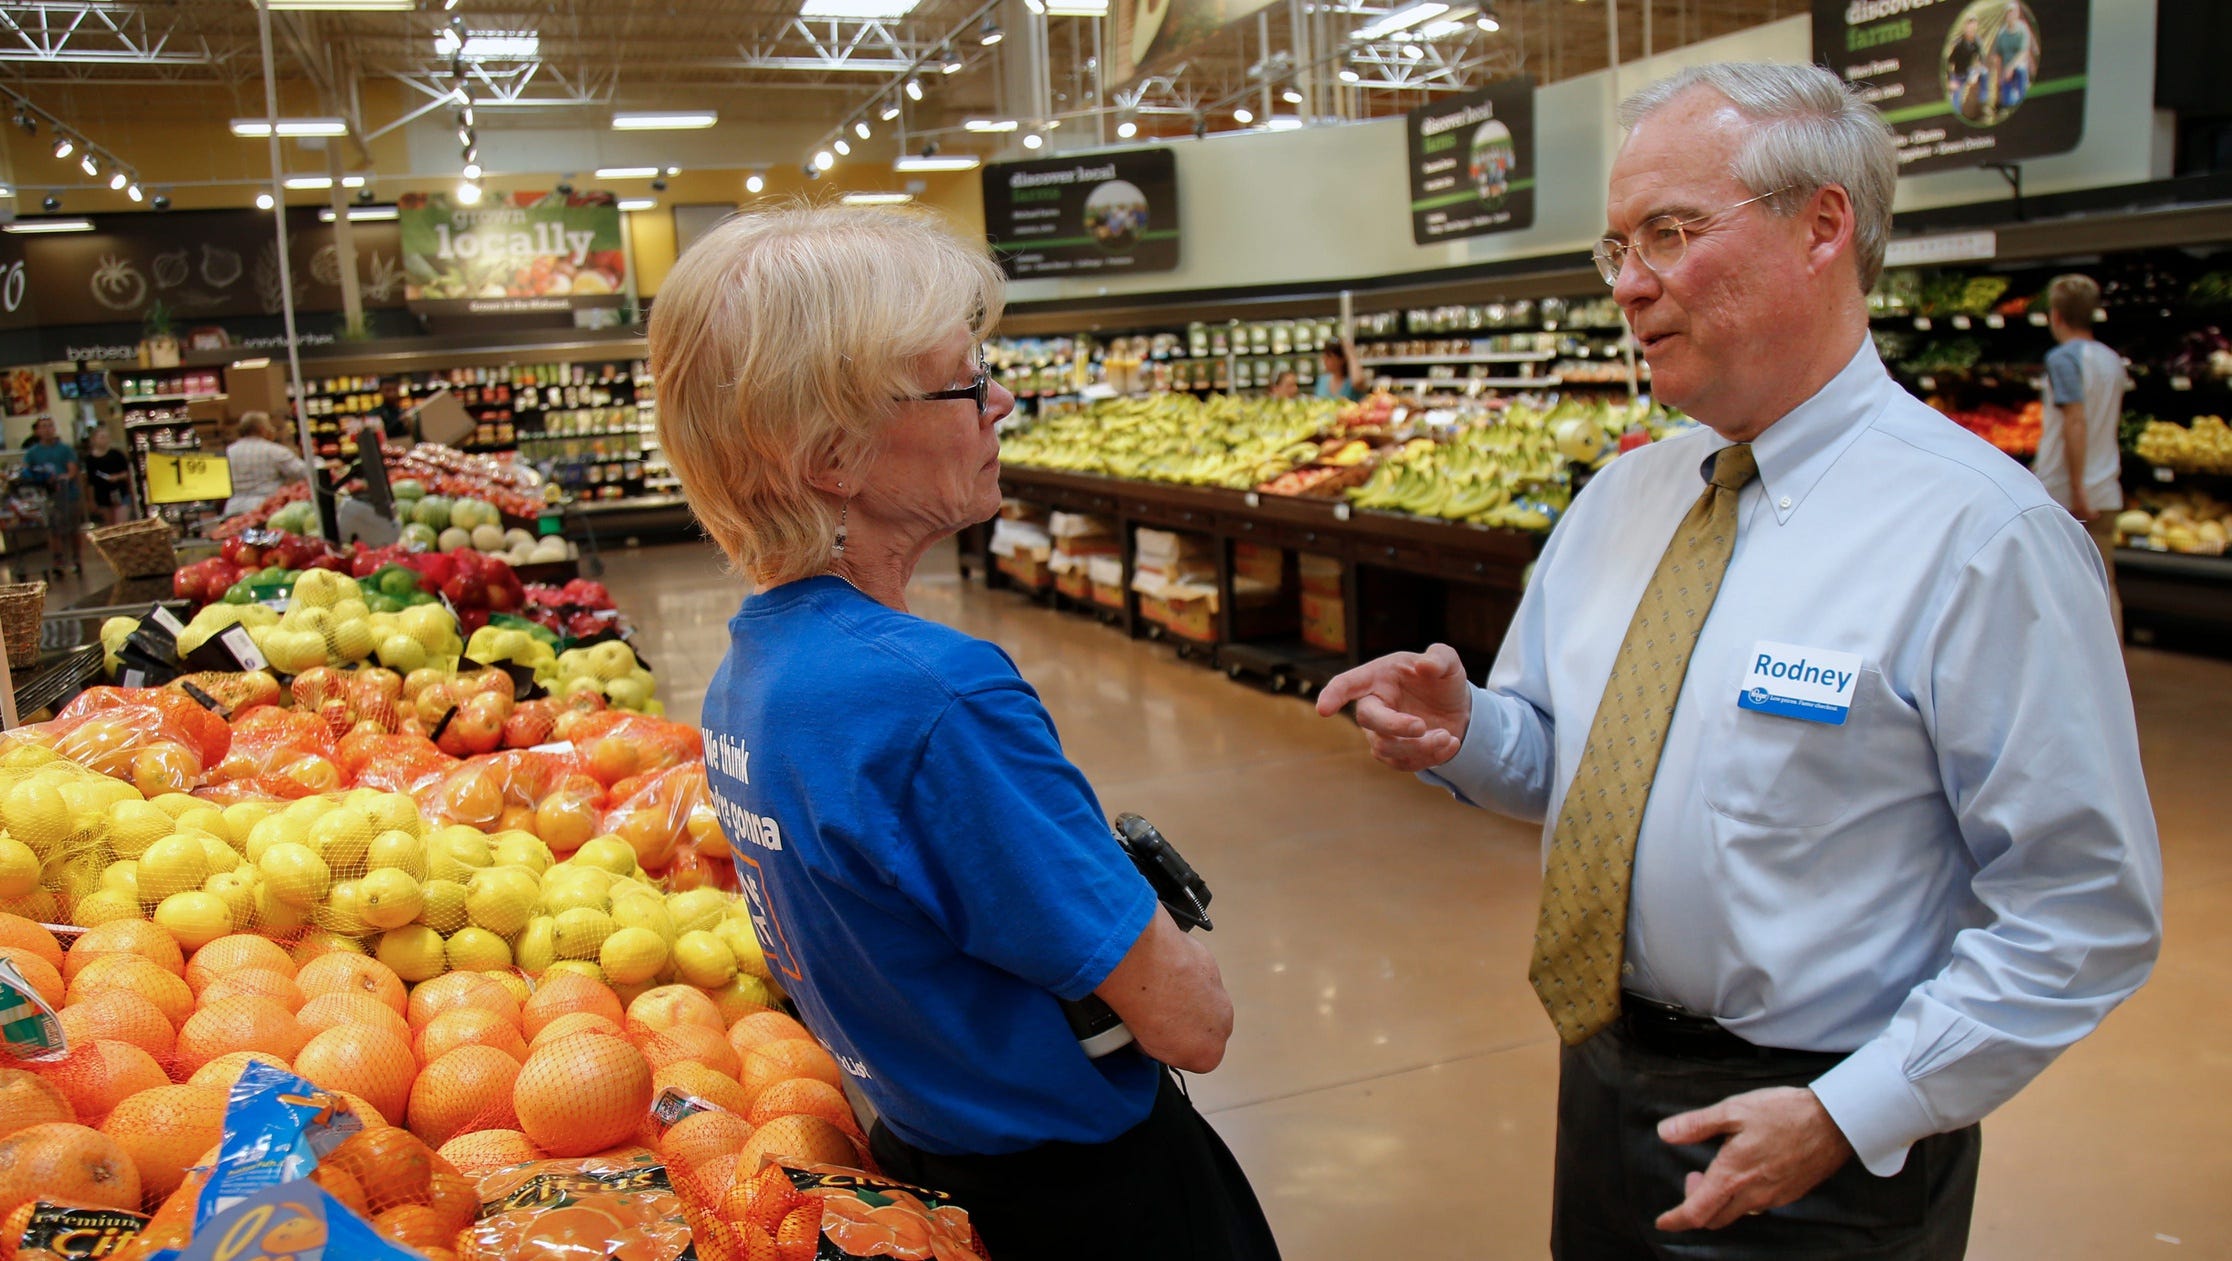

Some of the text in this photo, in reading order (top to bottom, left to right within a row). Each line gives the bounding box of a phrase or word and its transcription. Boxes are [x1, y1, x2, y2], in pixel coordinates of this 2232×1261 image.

[1847, 19, 1912, 52] farms
[1421, 100, 1494, 136] discover local
[1009, 164, 1116, 188] discover local
[452, 208, 527, 230] grown
[434, 221, 596, 267] locally
[1754, 652, 1853, 693] Rodney
[701, 727, 750, 785] We think
[730, 801, 783, 851] gonna
